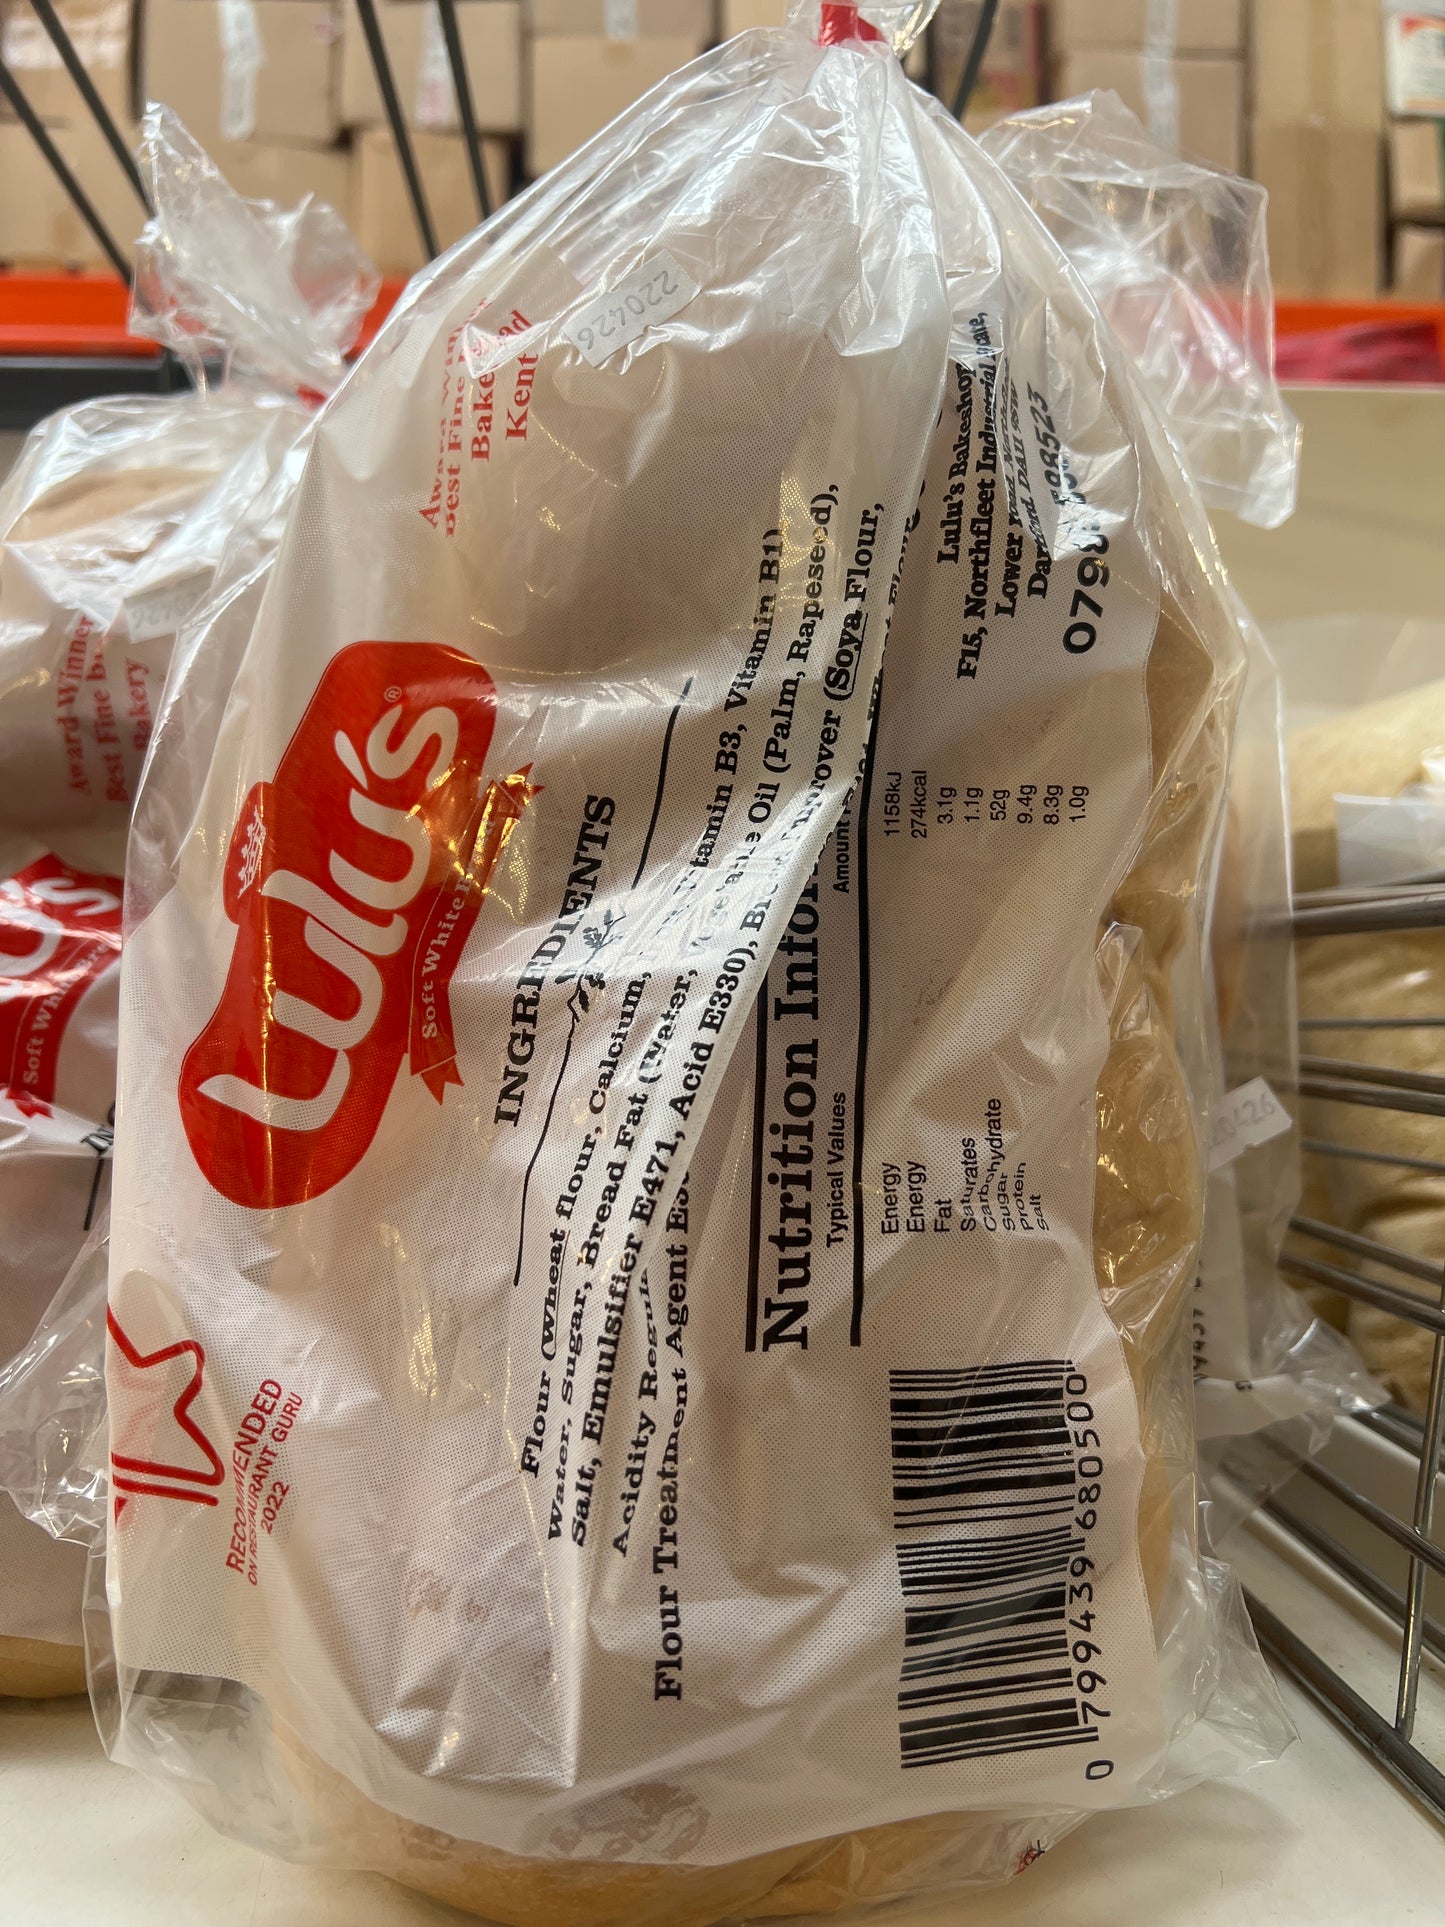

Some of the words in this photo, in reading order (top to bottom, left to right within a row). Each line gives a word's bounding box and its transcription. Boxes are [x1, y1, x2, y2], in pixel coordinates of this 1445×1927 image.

[577, 270, 679, 350] 220426
[448, 376, 465, 453] Fine
[505, 352, 539, 442] Kent
[948, 362, 976, 485] Bakeshop
[418, 416, 447, 529] Award
[844, 503, 884, 601] Flour,
[937, 485, 966, 564] Lulu's
[964, 478, 996, 620] Northfleet
[786, 483, 840, 664] Rapeseed),
[995, 532, 1023, 618] Lower
[724, 595, 777, 713] Vitamin
[823, 611, 868, 700] (Soya
[957, 627, 988, 680] F15,
[56, 717, 92, 797] Award
[94, 688, 120, 745] Fine
[715, 723, 748, 777] B3,
[763, 670, 805, 774] (Palm,
[103, 753, 130, 802] Best
[747, 781, 780, 828] Oil
[884, 772, 902, 837] 1158kJ
[912, 770, 927, 839] 274kcal
[938, 785, 957, 824] 3.1g
[964, 786, 983, 823] 1.1g
[990, 788, 1010, 822] 52g
[832, 818, 850, 894] Amount
[196, 703, 460, 1132] Lulu's
[422, 896, 466, 976] White
[494, 794, 615, 1127] INGREDIENTS
[422, 980, 438, 1039] Soft
[698, 940, 759, 1035] E330),
[996, 1172, 1016, 1231] Sugar
[1017, 784, 1037, 825] 9.4g
[1014, 1162, 1034, 1231] Protein
[1043, 784, 1063, 825] 8.3g
[1029, 1194, 1050, 1231] Salt
[1070, 784, 1089, 822] 1.0g
[23, 1036, 45, 1085] Soft
[588, 970, 652, 1115] Calcium,
[667, 1042, 715, 1122] Acid
[615, 1092, 649, 1151] Fat
[832, 1091, 847, 1168] Values
[978, 1097, 1005, 1232] Carbohydrate
[555, 1125, 602, 1221] flour,
[577, 1158, 628, 1270] Bread
[630, 1127, 687, 1226] E471,
[762, 1038, 819, 1352] Nutrition
[826, 1170, 844, 1249] Typical
[881, 1162, 901, 1235] Energy
[906, 1160, 926, 1233] Energy
[934, 1198, 951, 1233] Fat
[960, 1137, 978, 1232] Saturates
[541, 1228, 570, 1361] (Wheat
[581, 1231, 644, 1446] Emulsifier
[665, 1245, 689, 1357] Agent
[561, 1280, 593, 1405] Sugar,
[271, 1391, 303, 1443] GURU
[521, 1370, 551, 1478] Flour
[226, 1378, 282, 1574] RECOMMENDED
[247, 1444, 278, 1557] RESTAURANT
[260, 1480, 290, 1535] 2022
[548, 1419, 572, 1541] Water,
[571, 1447, 602, 1548] Salt,
[613, 1410, 657, 1557] Acidity
[653, 1367, 688, 1574] Treatment
[247, 1557, 258, 1586] ON
[653, 1585, 684, 1701] Flour
